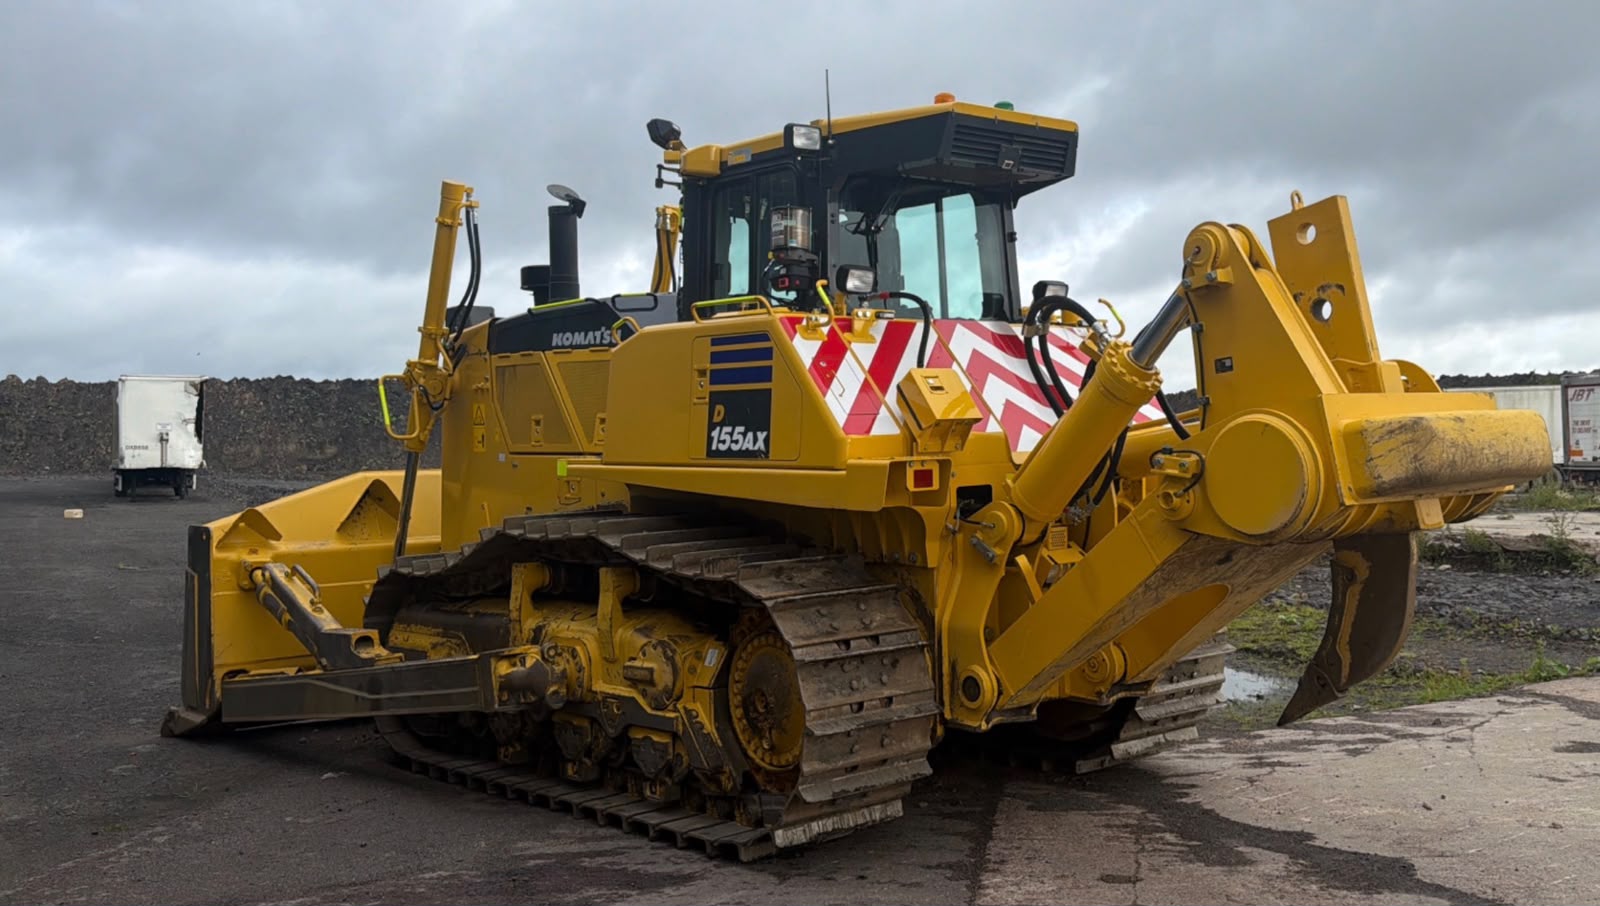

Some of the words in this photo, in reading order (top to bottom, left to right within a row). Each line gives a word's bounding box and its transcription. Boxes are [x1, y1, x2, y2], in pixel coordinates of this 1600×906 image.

[1570, 388, 1595, 401] JBT
[712, 404, 725, 423] D
[710, 426, 768, 452] 155AX
